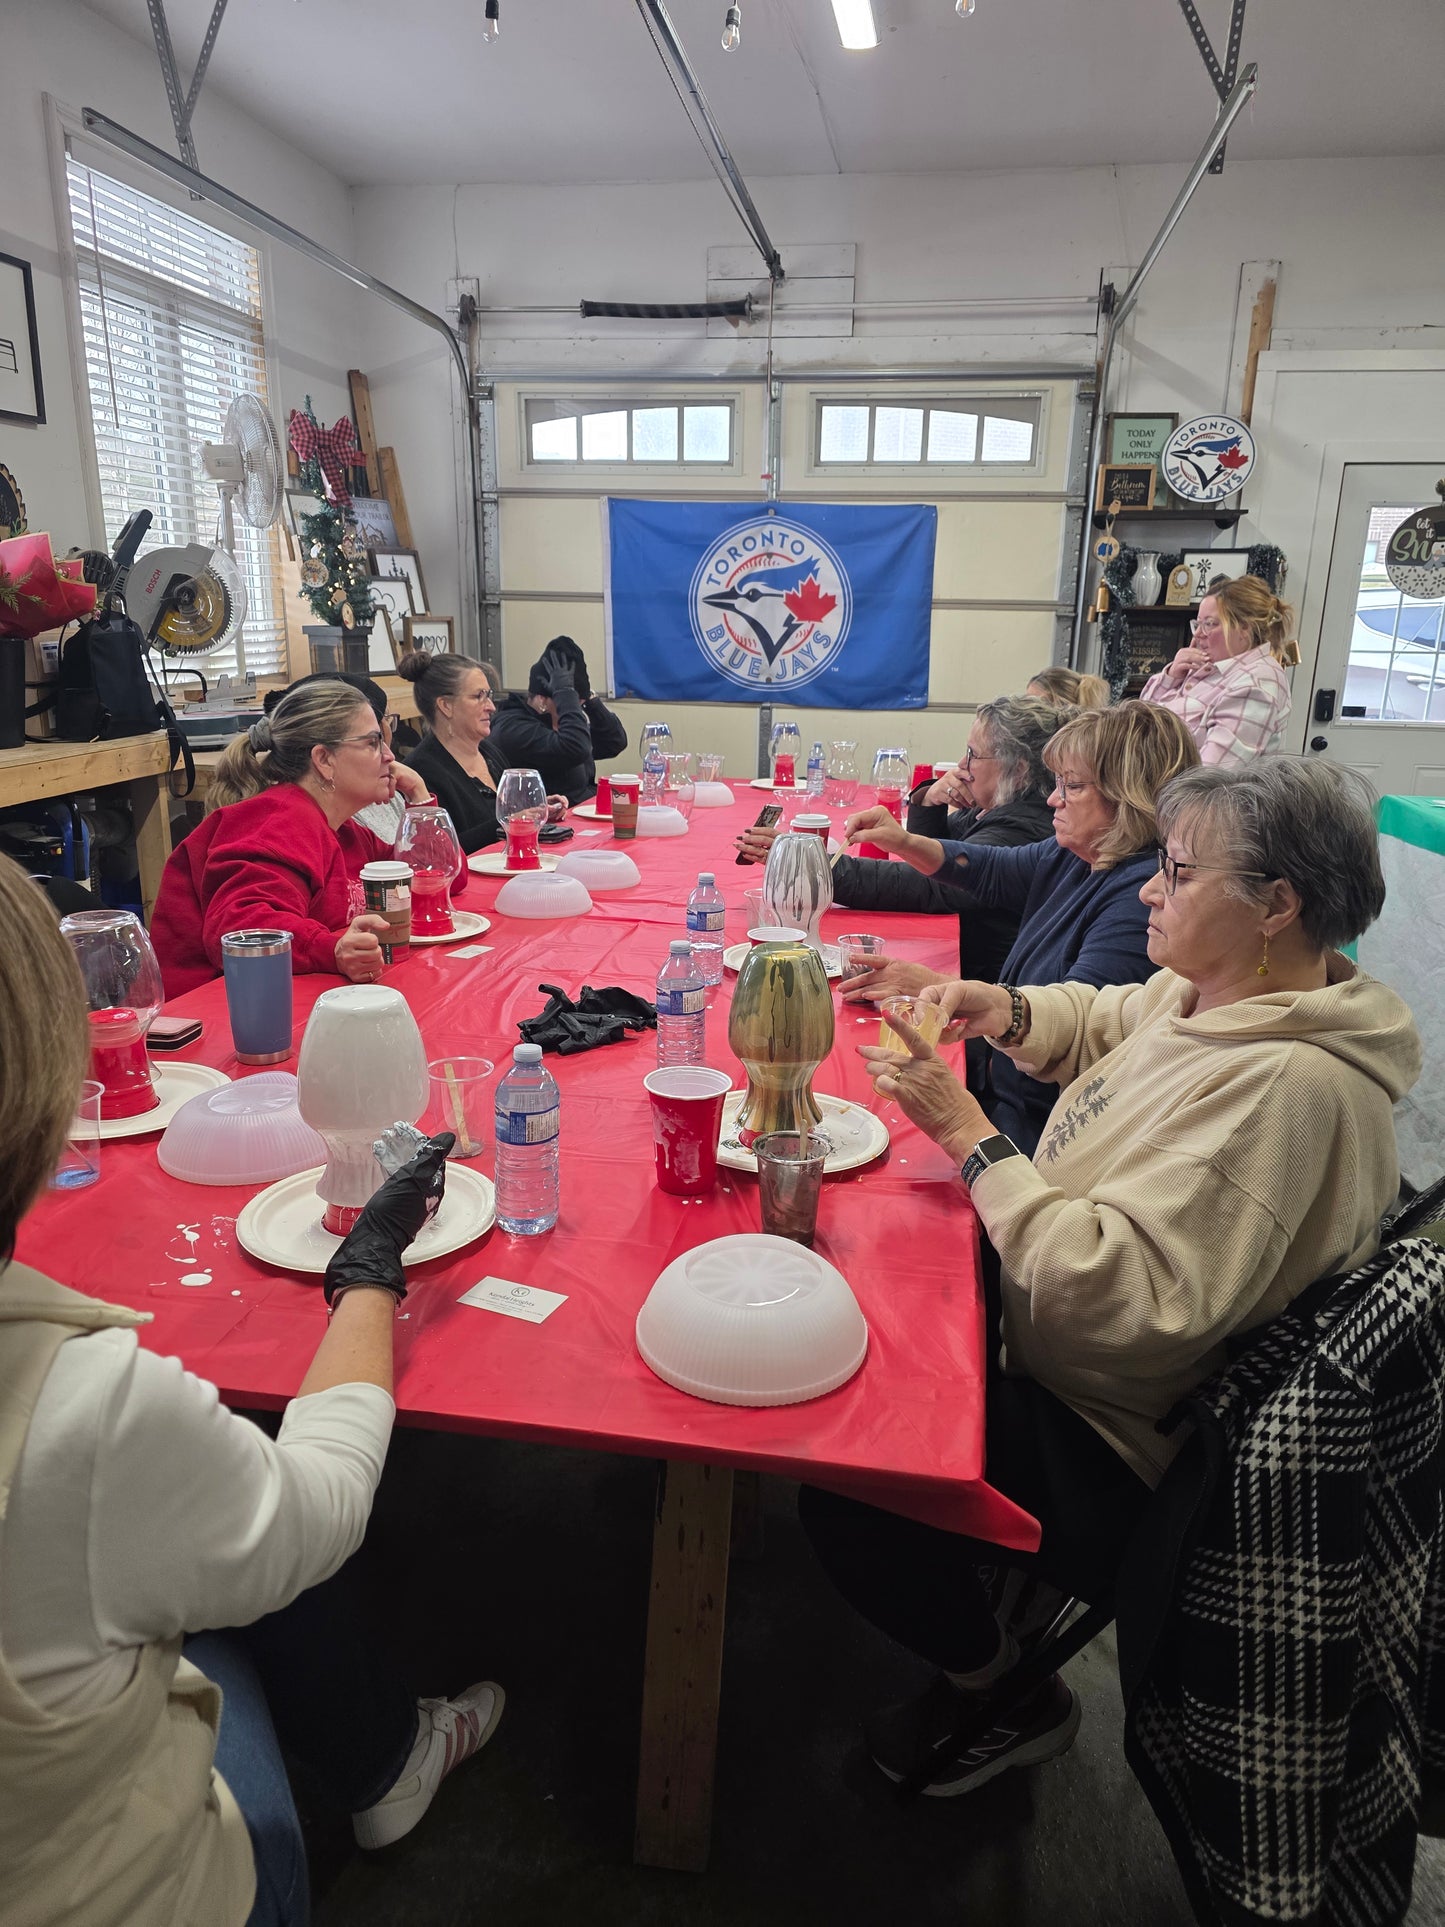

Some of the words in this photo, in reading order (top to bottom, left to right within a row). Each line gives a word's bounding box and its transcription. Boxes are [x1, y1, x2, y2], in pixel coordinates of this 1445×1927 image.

[1127, 429, 1156, 438] TODAY
[1174, 421, 1235, 447] TORONTO
[1129, 440, 1152, 449] ONLY
[1121, 451, 1160, 459] HAPPENS
[1167, 466, 1199, 497] BLUE
[1206, 473, 1243, 499] JAYS
[1416, 518, 1431, 529] let
[1425, 528, 1435, 539] it
[706, 530, 805, 587] TORONTO
[145, 569, 162, 594] BOSCH
[706, 623, 763, 679] BLUE
[775, 630, 832, 680] JAYS
